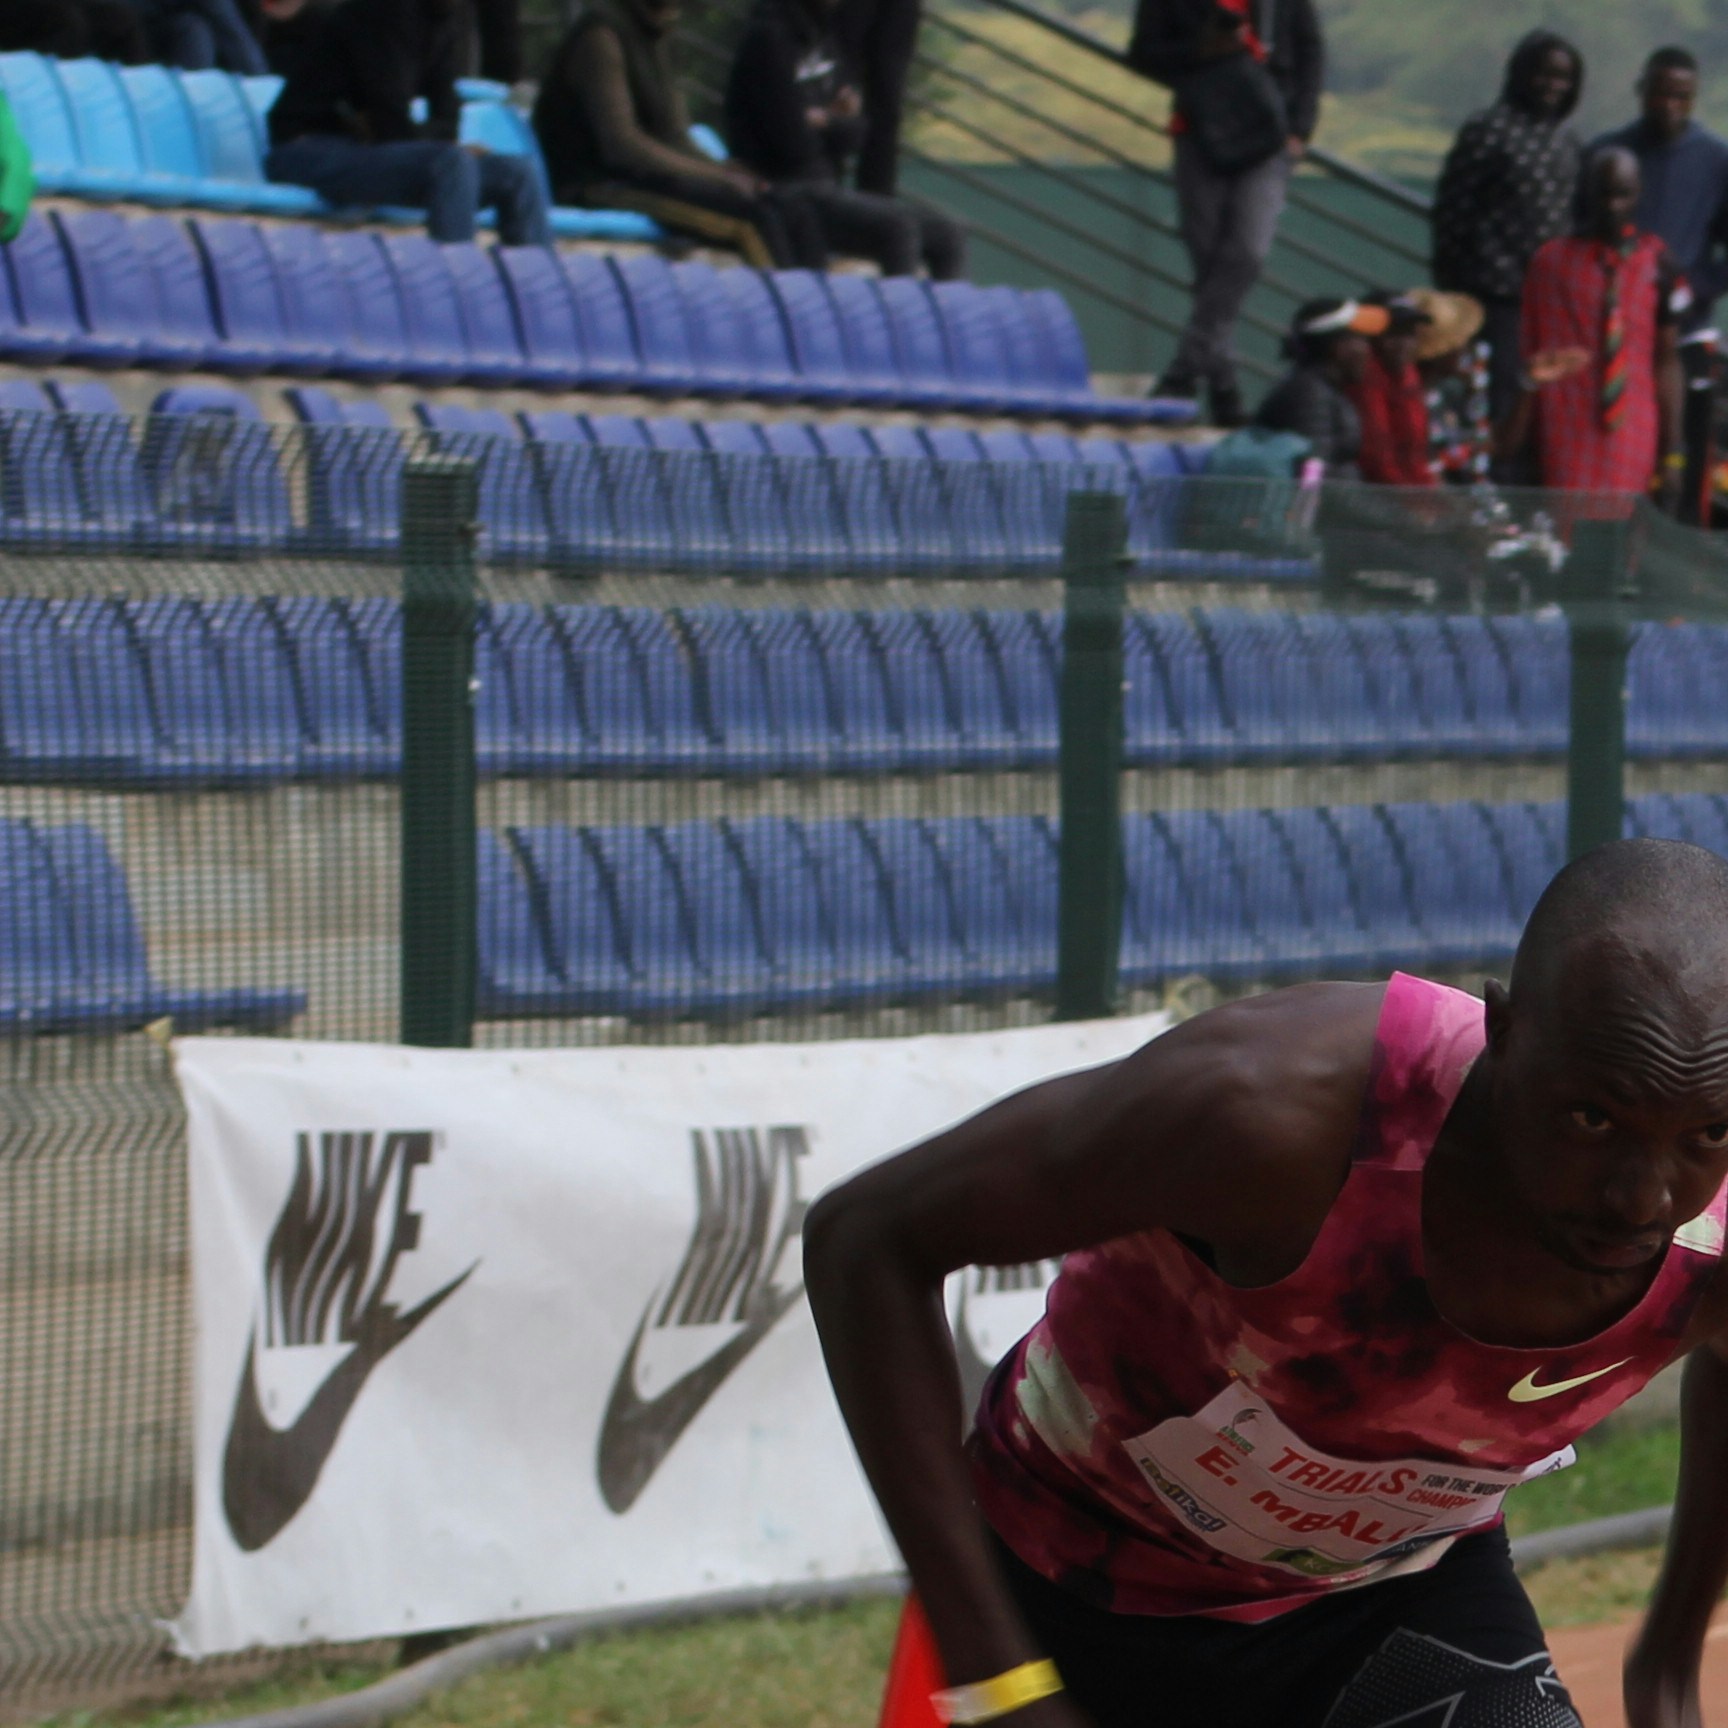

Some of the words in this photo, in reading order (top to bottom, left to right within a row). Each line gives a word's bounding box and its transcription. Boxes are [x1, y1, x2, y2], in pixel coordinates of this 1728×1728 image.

[265, 1130, 433, 1348] NIKE
[654, 1126, 812, 1329] NIKE
[1195, 1445, 1240, 1487] E.
[1268, 1446, 1418, 1498] TRIALS
[1421, 1474, 1449, 1489] FOR
